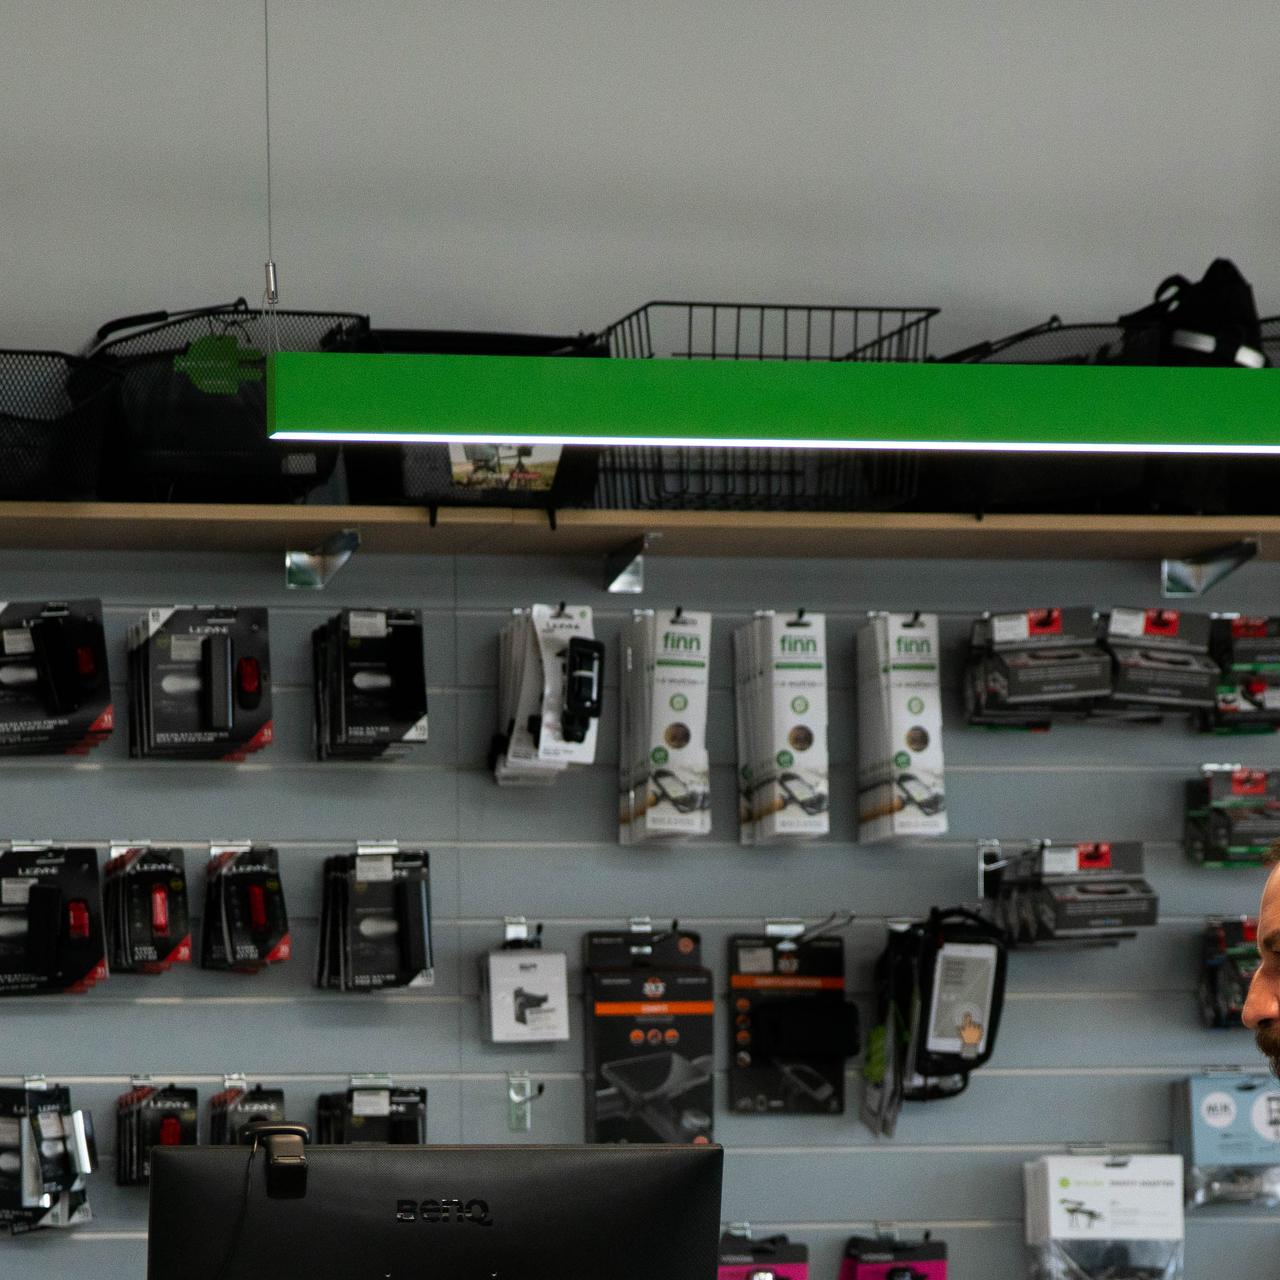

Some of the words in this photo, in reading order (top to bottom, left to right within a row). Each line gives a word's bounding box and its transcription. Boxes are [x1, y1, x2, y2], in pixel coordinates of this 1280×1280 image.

[663, 632, 701, 651] finn
[779, 634, 817, 652] finn
[896, 635, 931, 653] finn
[149, 1100, 190, 1110] LEZYNE
